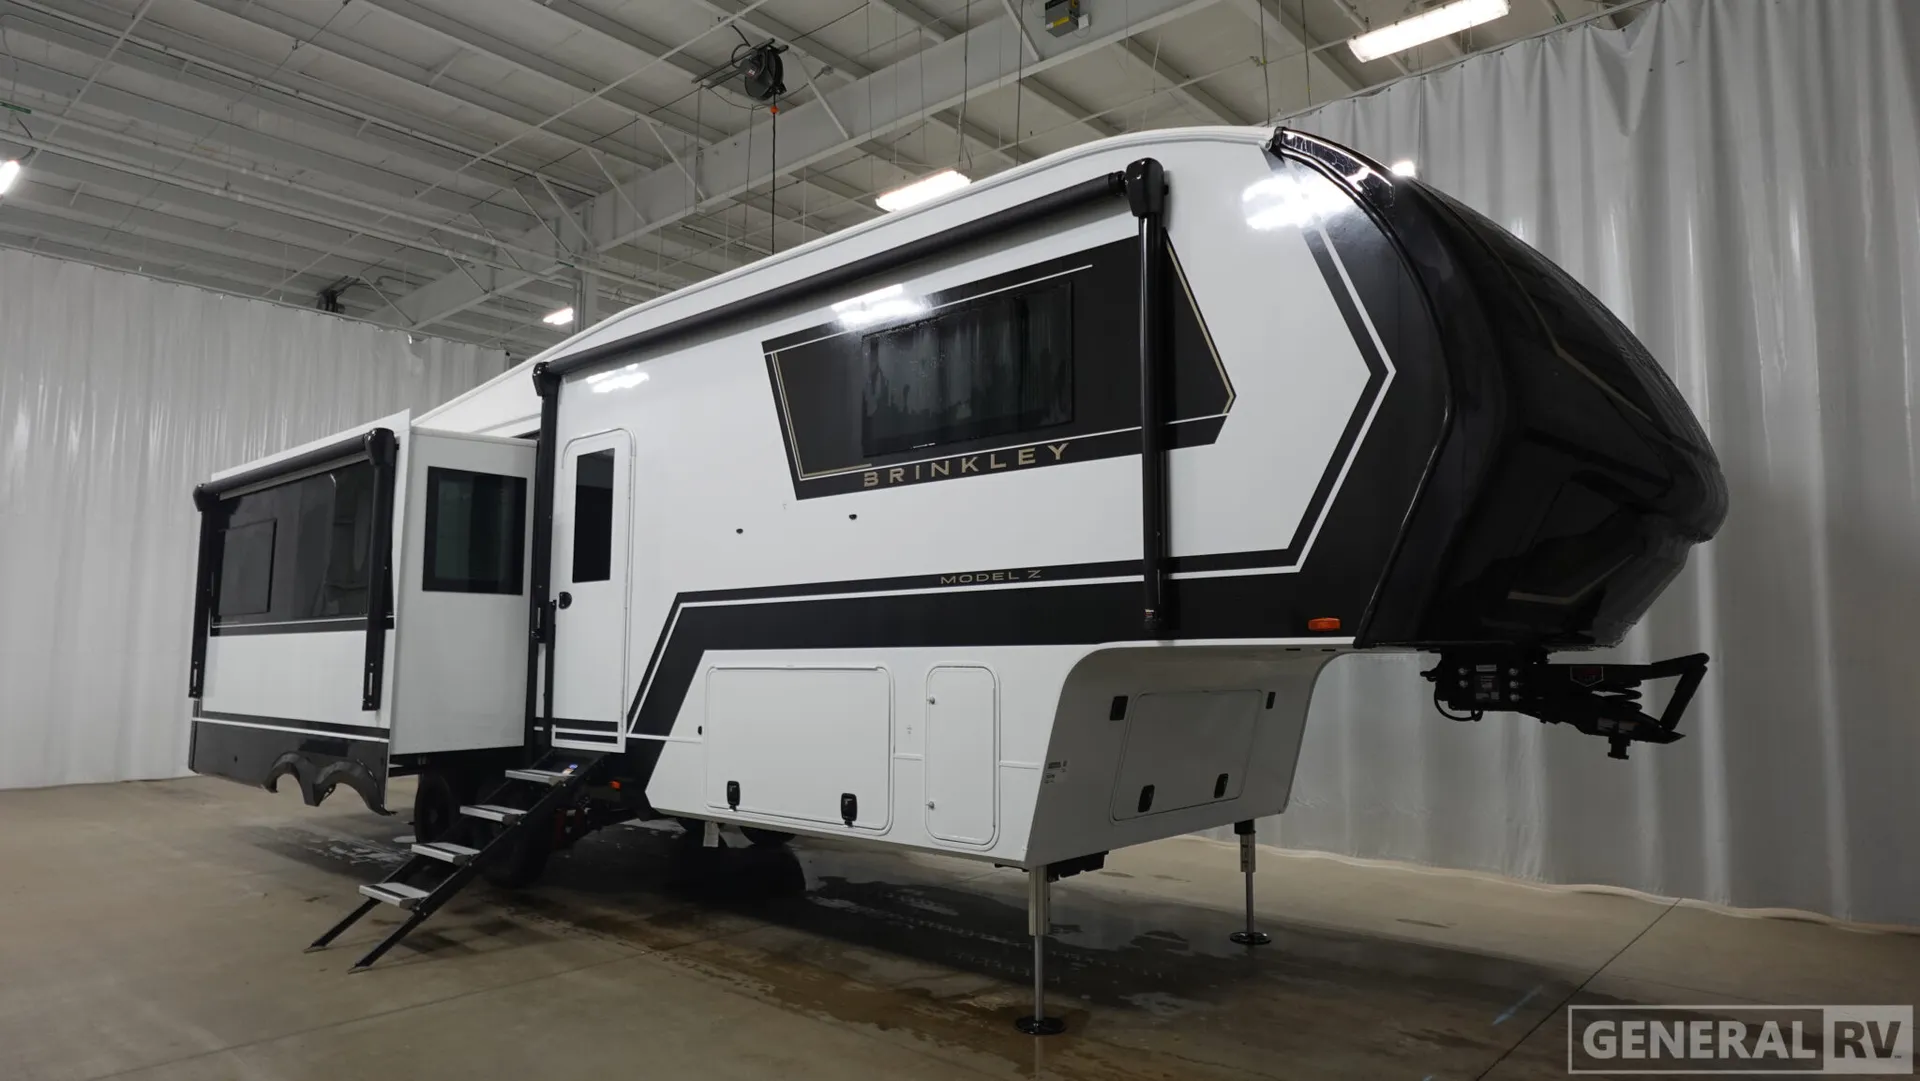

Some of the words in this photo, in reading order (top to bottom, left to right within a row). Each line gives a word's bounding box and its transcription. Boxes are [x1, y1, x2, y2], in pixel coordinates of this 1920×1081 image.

[863, 442, 1069, 487] BRINKLEY
[940, 571, 1020, 585] MODEL
[1027, 569, 1042, 579] Z
